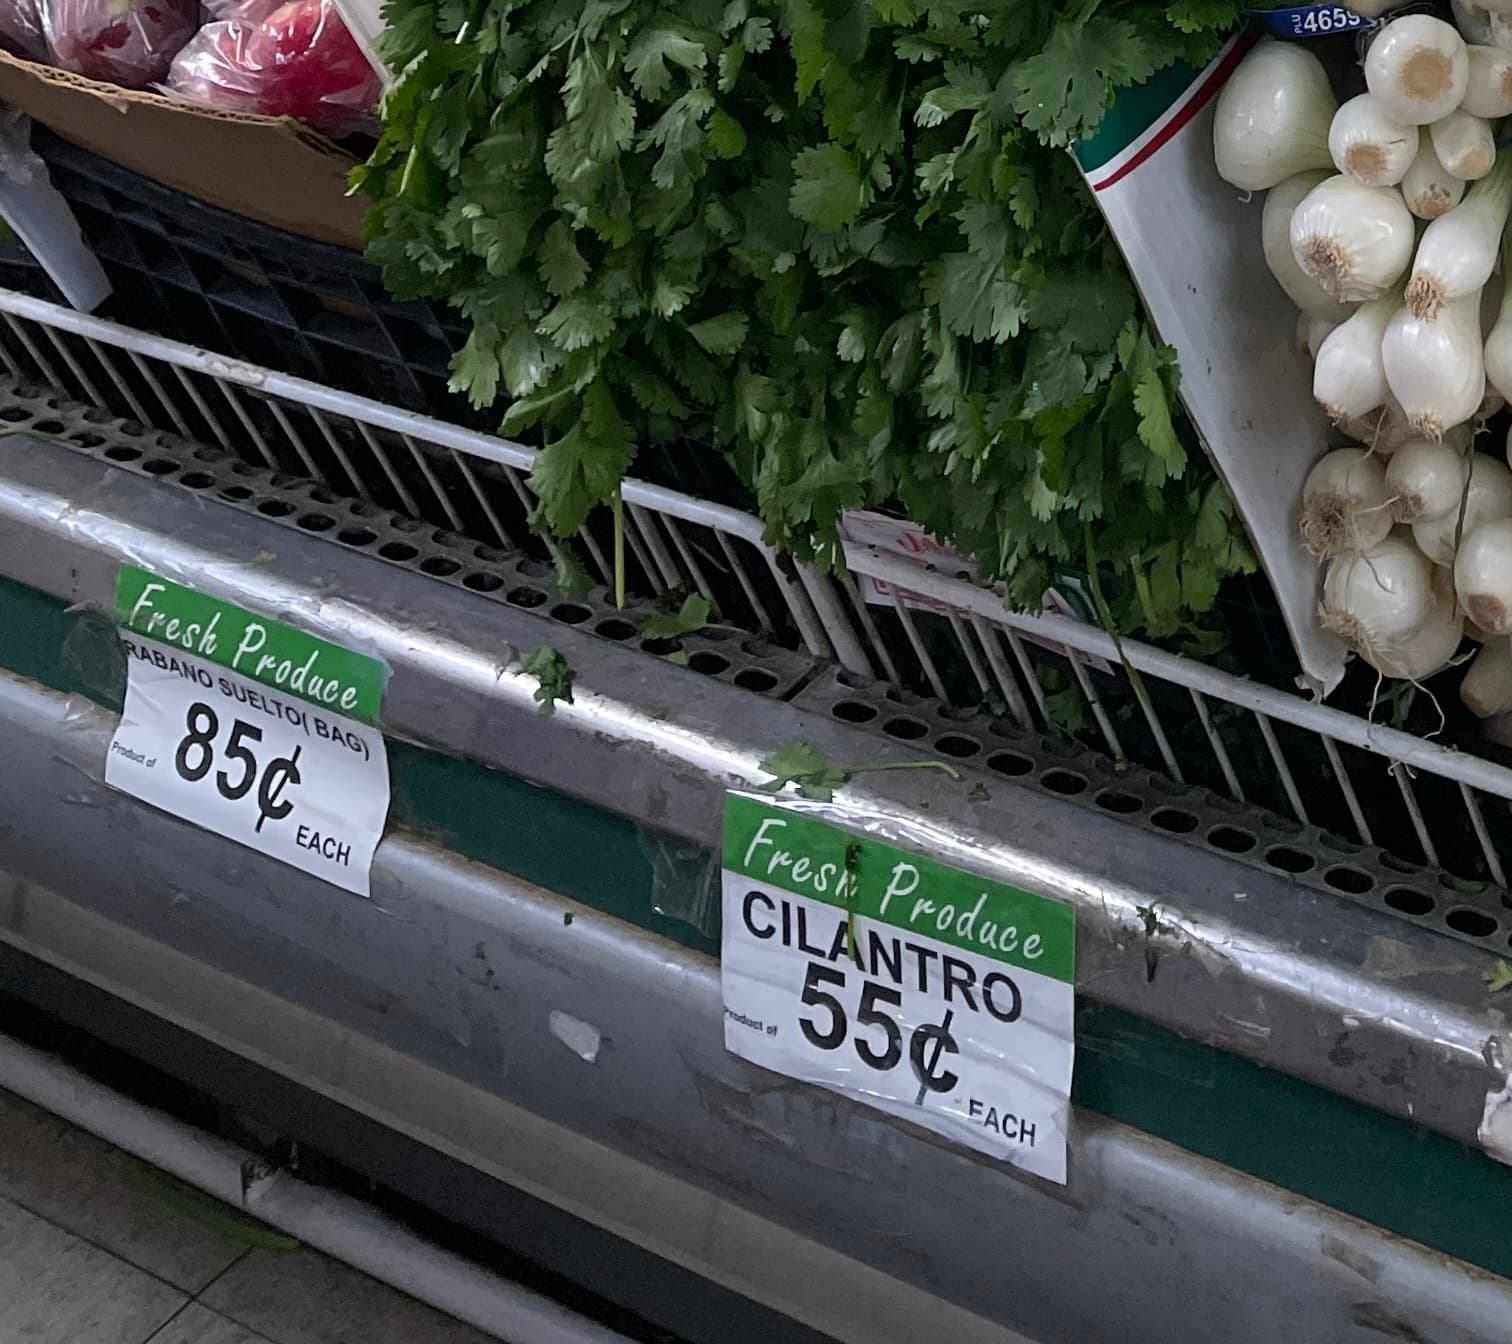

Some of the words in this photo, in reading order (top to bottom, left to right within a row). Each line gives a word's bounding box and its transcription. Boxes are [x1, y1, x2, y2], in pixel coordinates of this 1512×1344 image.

[126, 639, 214, 690] RABANO
[127, 583, 220, 653] Fresh
[232, 622, 359, 710] Produce
[111, 740, 145, 767] Product
[175, 702, 302, 834] 85¢
[296, 825, 352, 866] EACH
[743, 817, 859, 898] Fresh
[879, 862, 1045, 961] Produce
[742, 890, 1022, 1024] CILANTRO
[798, 960, 960, 1106] 55¢
[968, 1098, 1037, 1148] EACH
